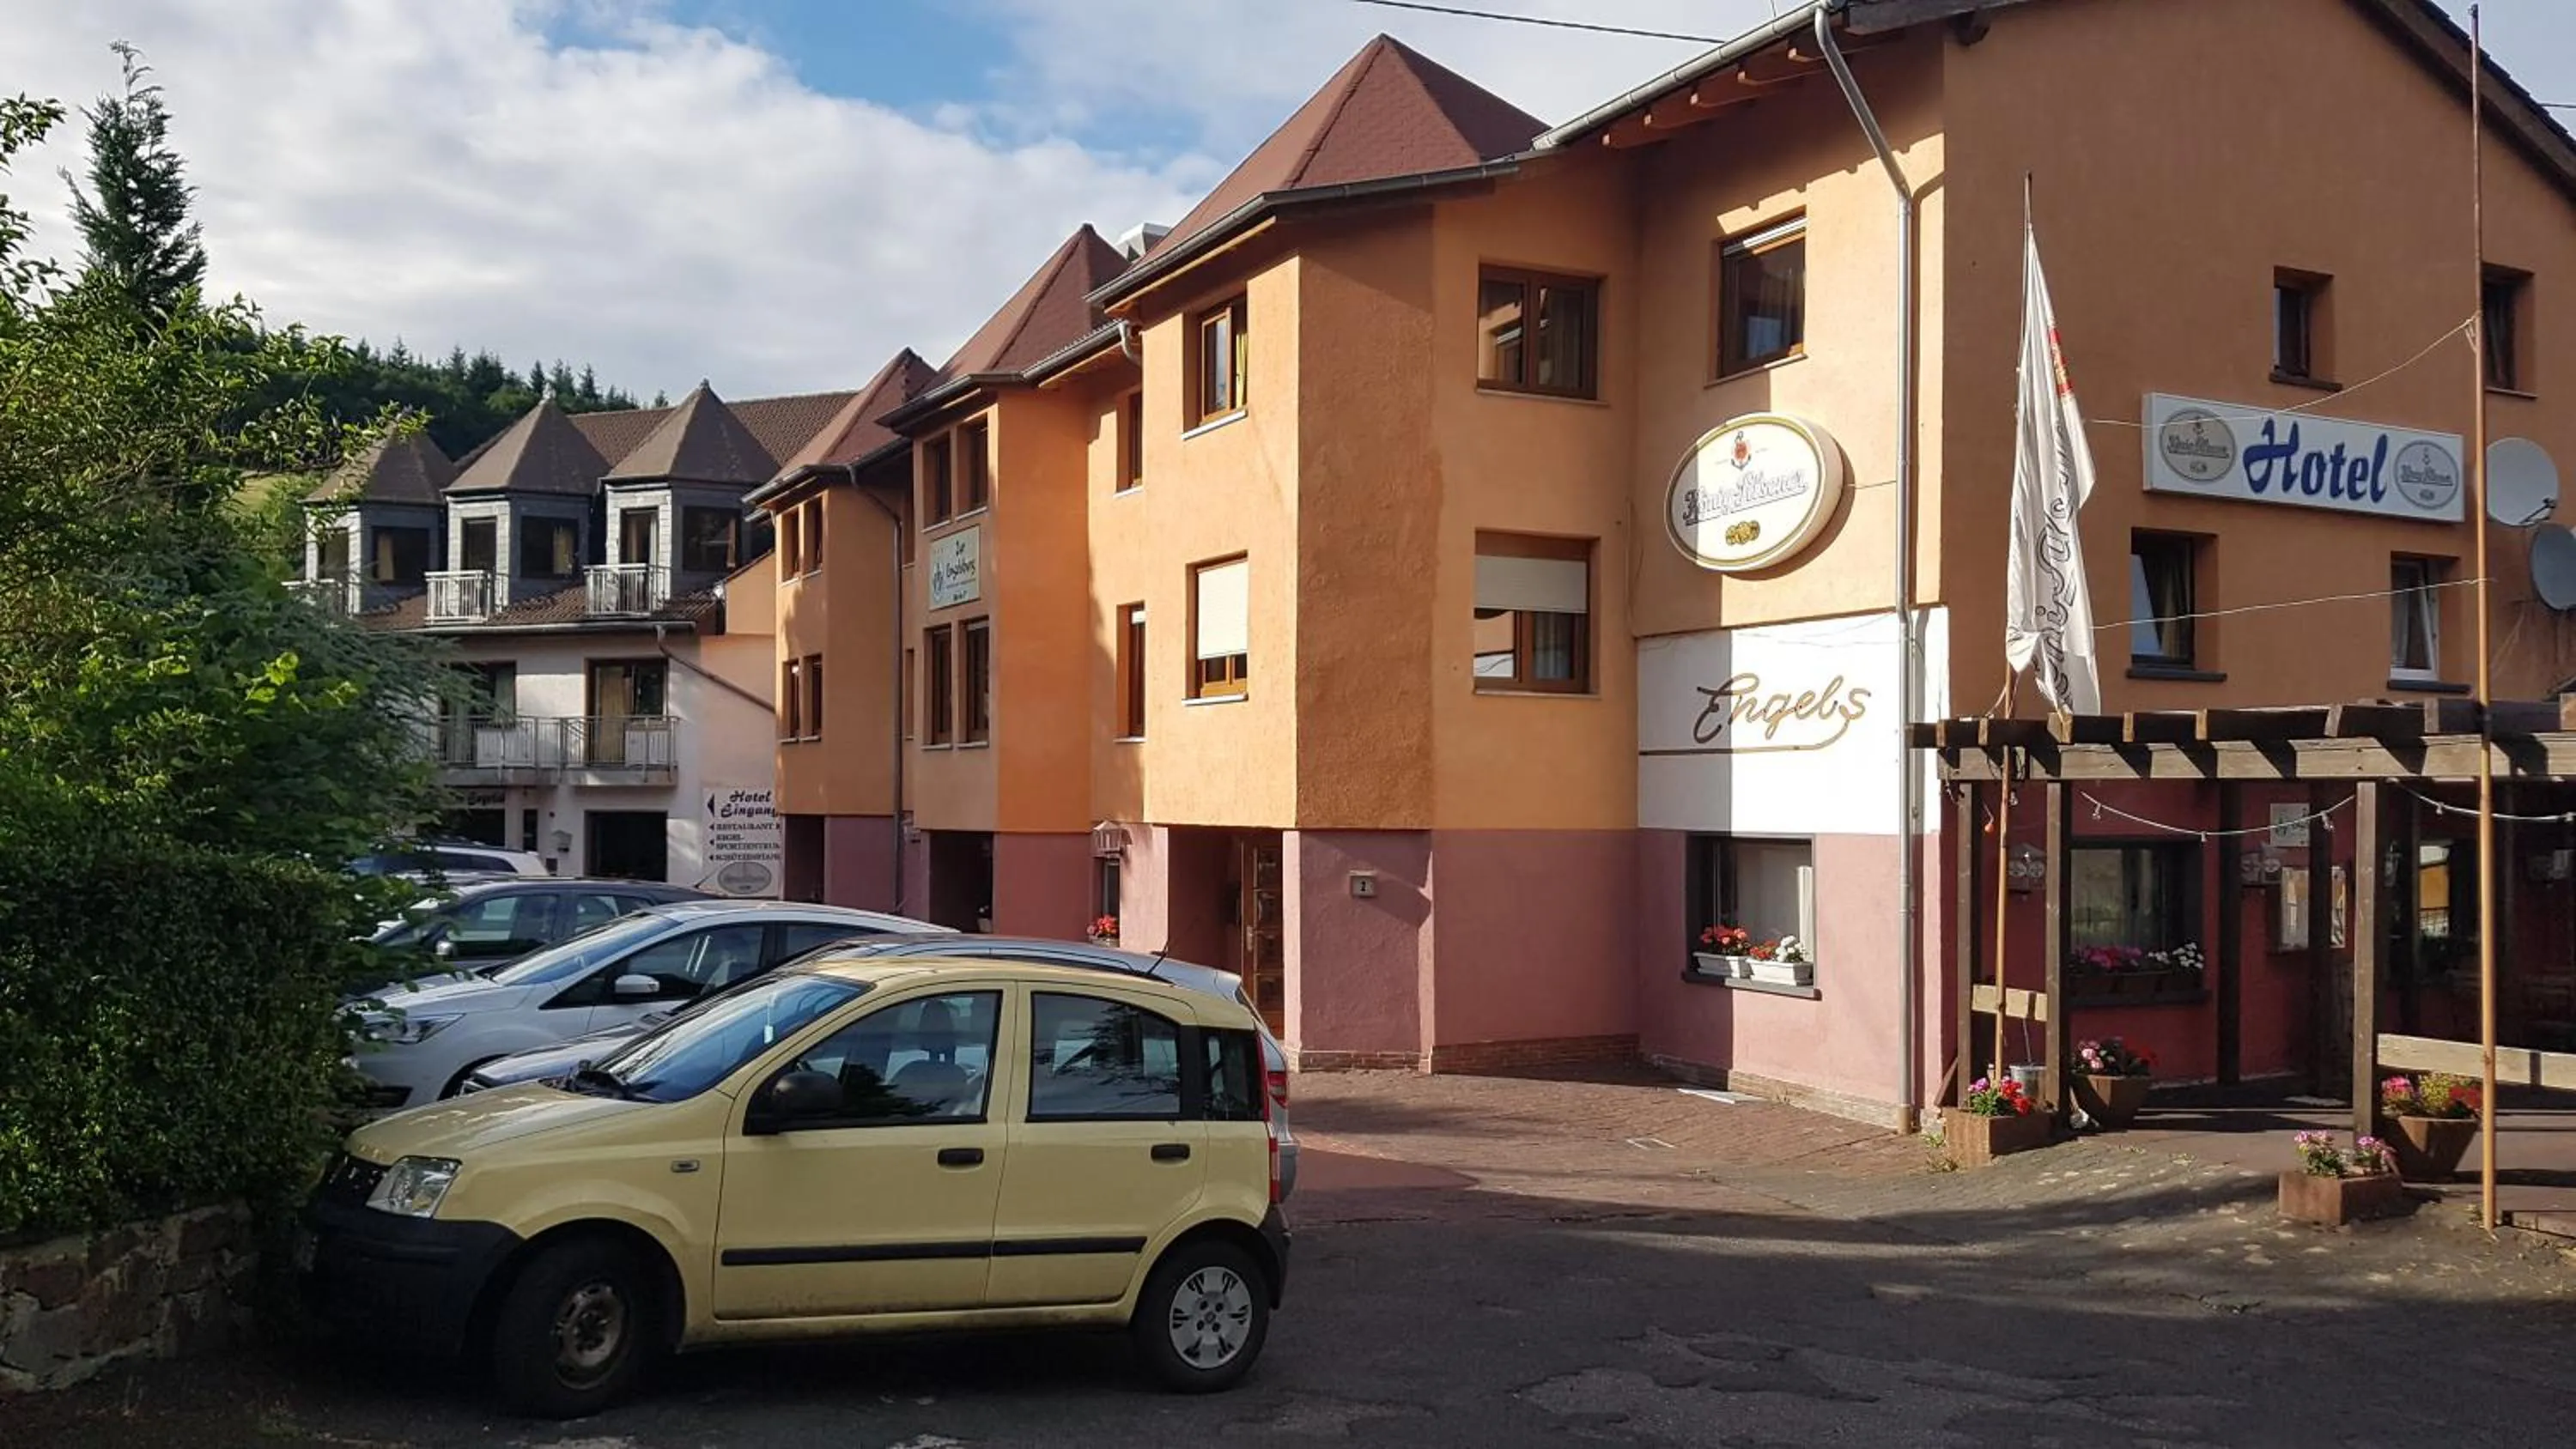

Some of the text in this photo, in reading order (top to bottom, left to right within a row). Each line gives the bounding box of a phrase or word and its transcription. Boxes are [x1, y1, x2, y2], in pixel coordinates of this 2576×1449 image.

[2242, 417, 2387, 504] Hotel
[1692, 672, 1871, 743] Engels
[729, 790, 771, 803] Hotel
[716, 822, 773, 831] RESTAURANT
